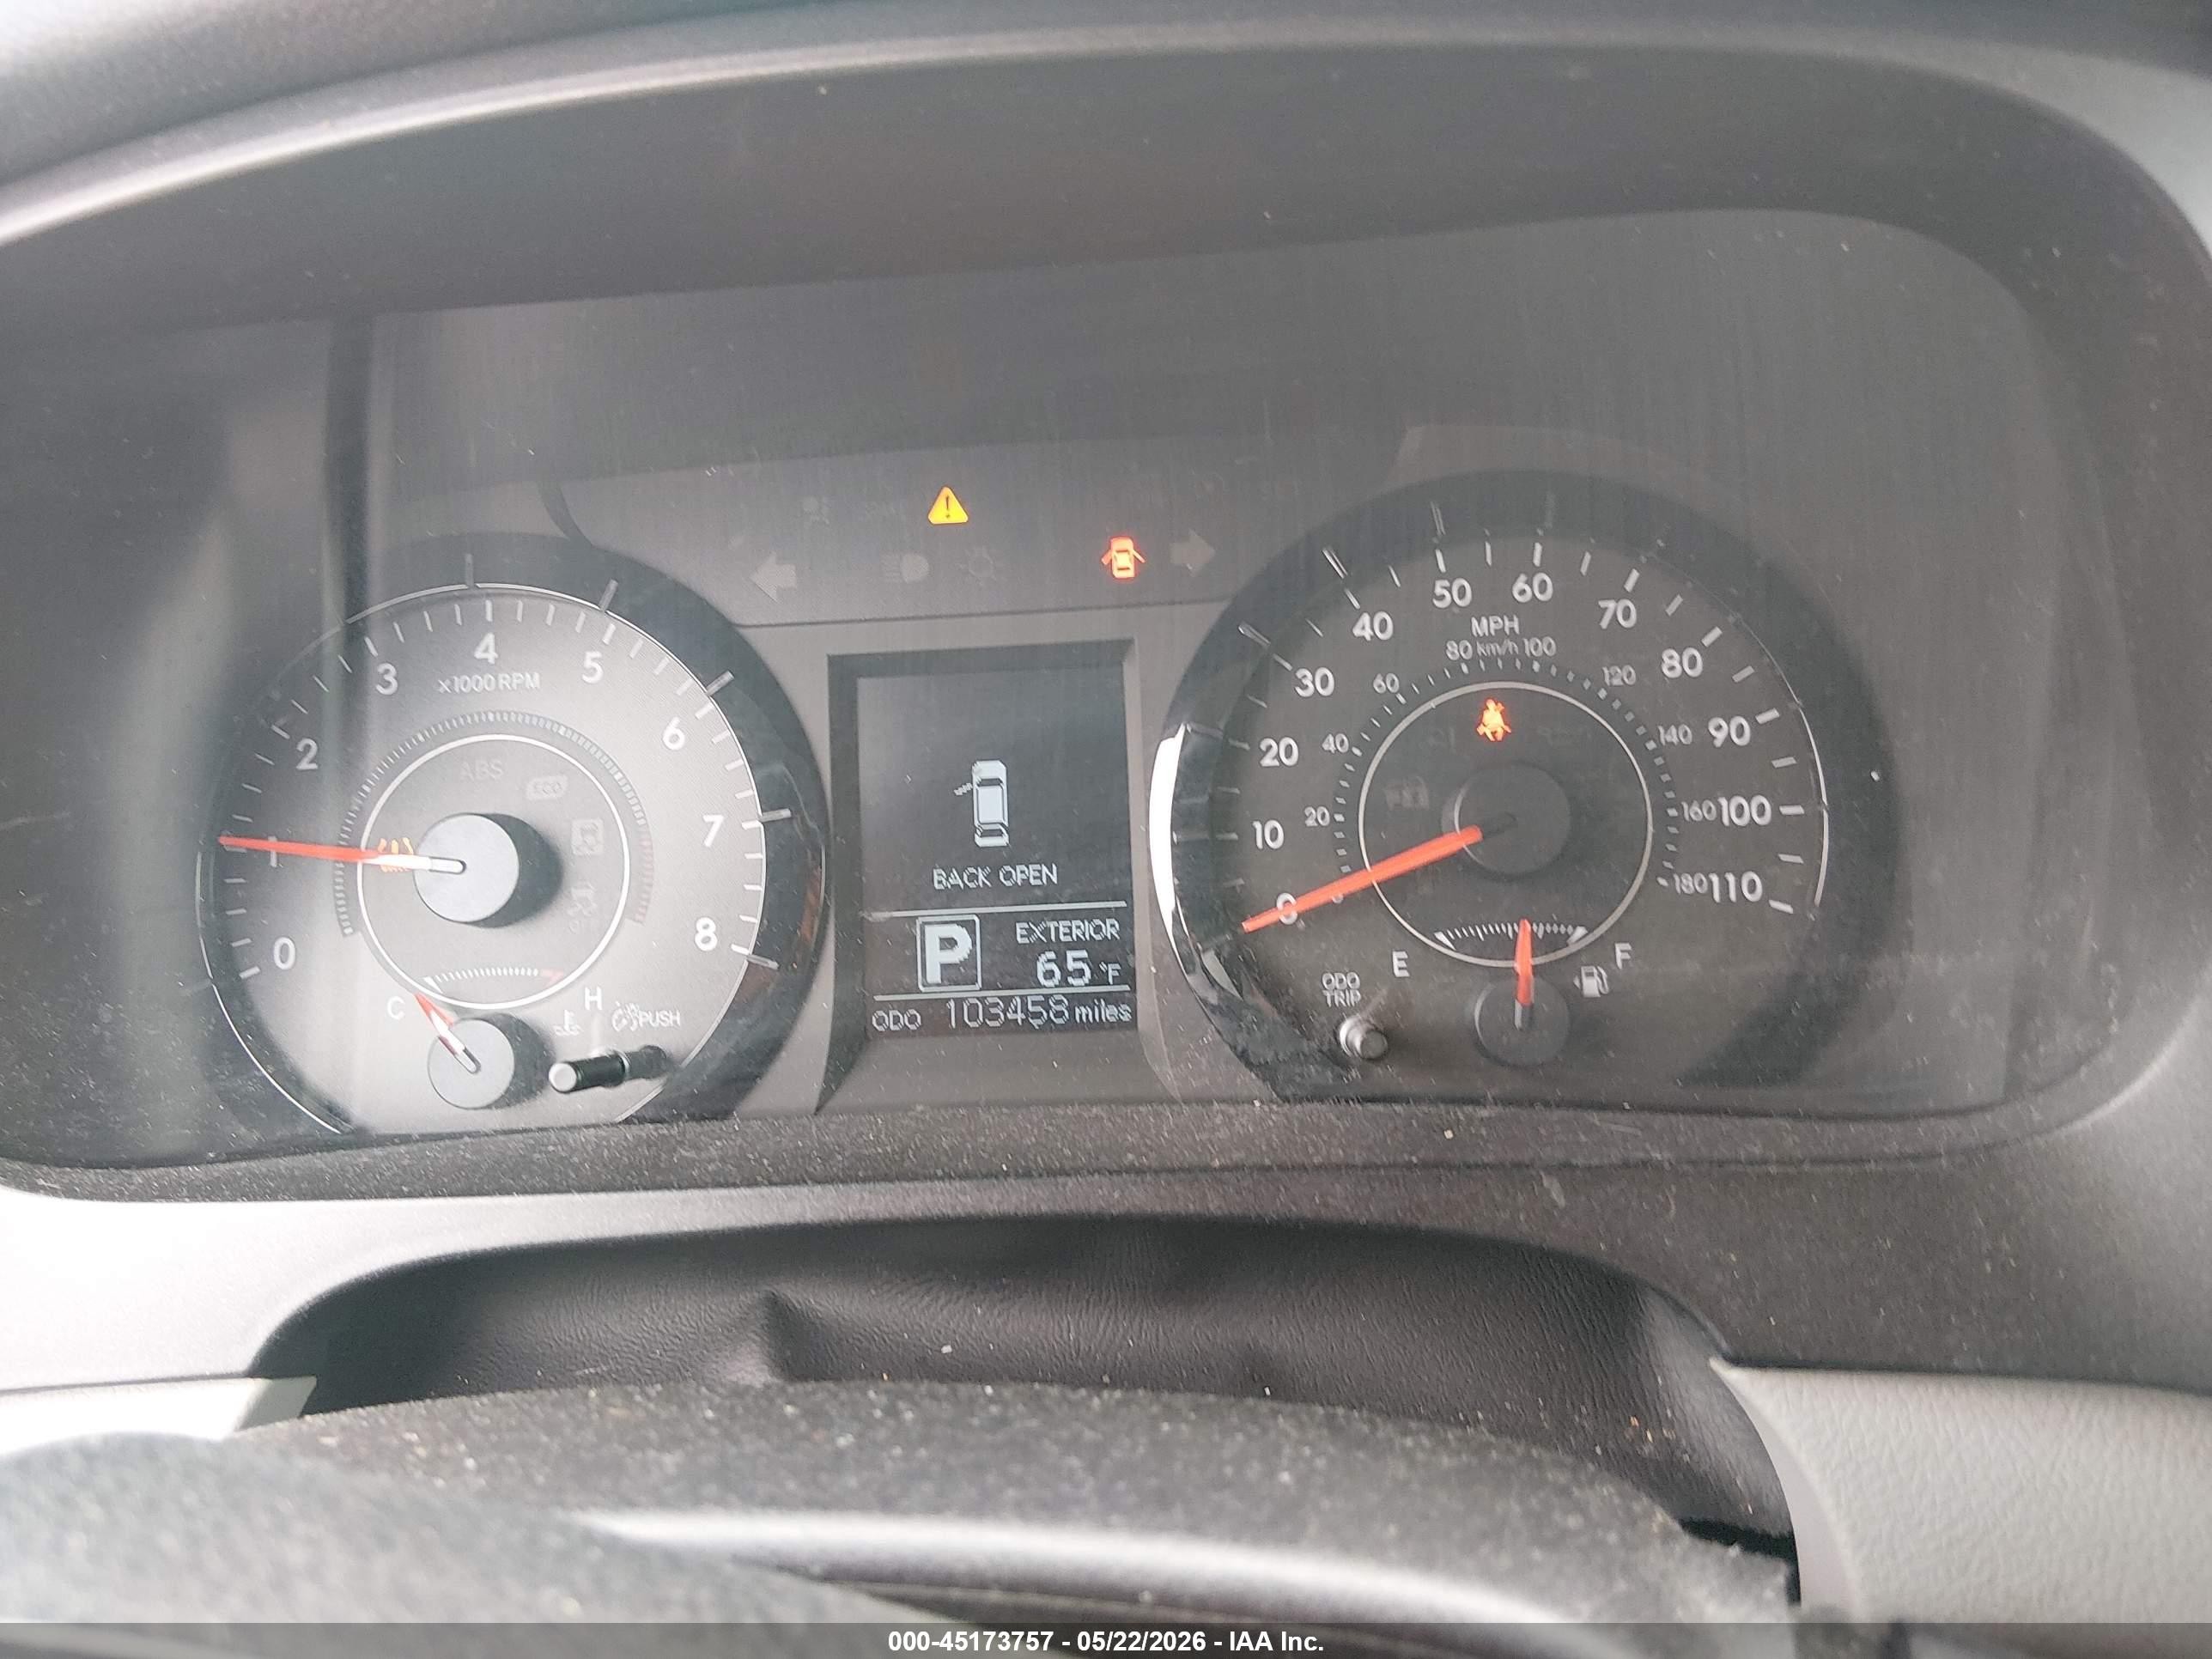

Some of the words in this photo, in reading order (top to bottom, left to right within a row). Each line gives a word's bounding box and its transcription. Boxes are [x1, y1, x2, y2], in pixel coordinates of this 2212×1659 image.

[1432, 577, 1473, 609] 50
[1512, 572, 1553, 603] 60
[1352, 611, 1394, 641] 40
[1471, 614, 1520, 637] MPH
[1598, 599, 1638, 629] 70
[474, 632, 499, 665] 4
[1445, 639, 1473, 661] 80
[1476, 638, 1519, 656] km/h
[1523, 635, 1557, 658] 100
[581, 650, 604, 684] 5
[1601, 664, 1637, 686] 120
[1661, 647, 1704, 678] 80
[375, 662, 398, 696] 3
[497, 672, 542, 691] RPM
[1294, 666, 1335, 697] 30
[1374, 672, 1400, 694] 60
[662, 716, 685, 750] 6
[1321, 732, 1349, 754] 40
[1657, 723, 1692, 746] 140
[1707, 715, 1751, 748] 90
[295, 738, 319, 770] 2
[1259, 736, 1299, 767] 20
[1304, 805, 1331, 827] 20
[1680, 799, 1717, 822] 160
[1717, 794, 1772, 827] 100
[702, 815, 725, 848] 7
[1252, 819, 1285, 850] 10
[933, 866, 991, 890] BACK
[999, 863, 1058, 888] OPEN
[1673, 871, 1708, 895] 180
[1708, 871, 1763, 902] 110
[694, 917, 718, 951] 8
[1015, 919, 1121, 945] EXTERIOR
[273, 937, 296, 970] 0
[924, 923, 973, 985] P
[1036, 949, 1092, 988] 65
[1392, 951, 1410, 978] E
[1614, 944, 1632, 970] F
[1322, 971, 1361, 990] ODO
[386, 996, 405, 1020] C
[584, 986, 603, 1012] H
[871, 1008, 921, 1032] ODO
[945, 994, 1070, 1030] 103458
[1074, 998, 1133, 1025] miles
[1322, 989, 1361, 1008] TRIP
[638, 1009, 681, 1029] PUSH
